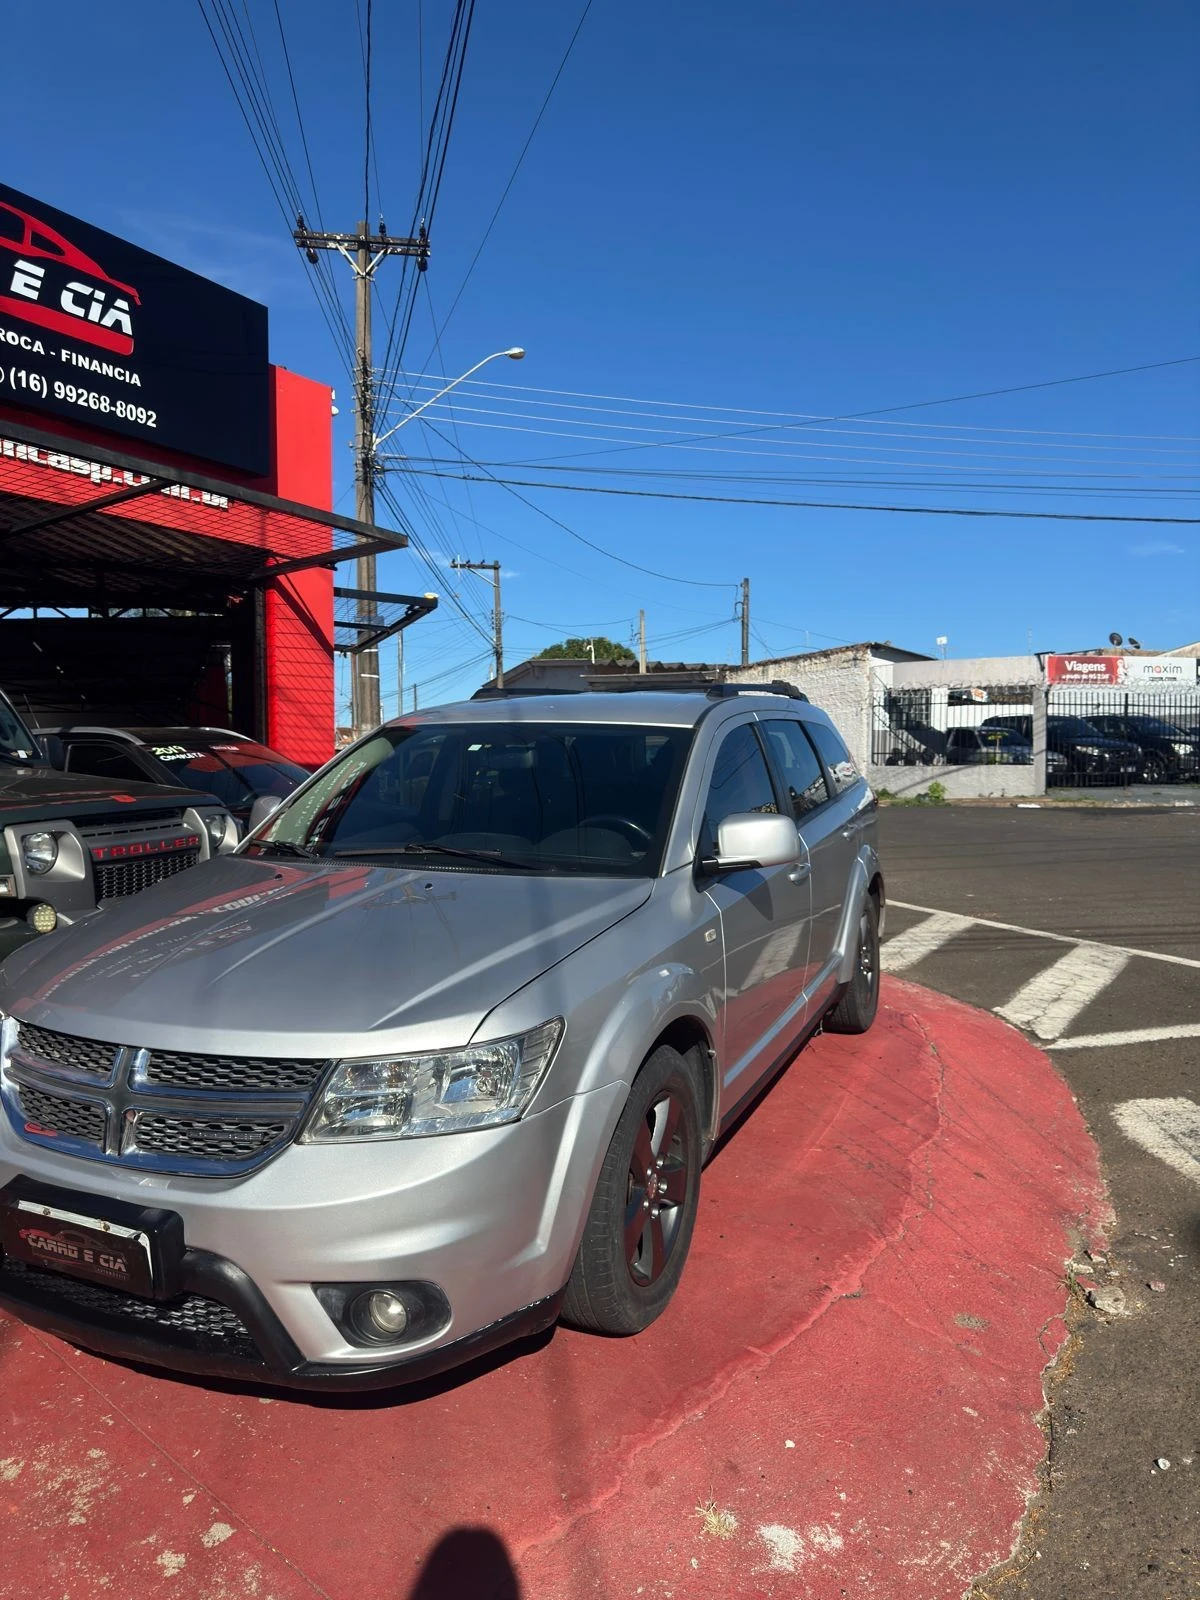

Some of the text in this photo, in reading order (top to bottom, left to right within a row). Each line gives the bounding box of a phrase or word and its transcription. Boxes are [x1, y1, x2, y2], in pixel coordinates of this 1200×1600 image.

[61, 348, 142, 387] FINANCIA
[9, 366, 157, 428] (16) 99268-8092
[1064, 660, 1106, 673] Viagens
[152, 745, 186, 755] 2019
[92, 836, 200, 860] TROLLER
[27, 1233, 127, 1272] CARRO E CIA
